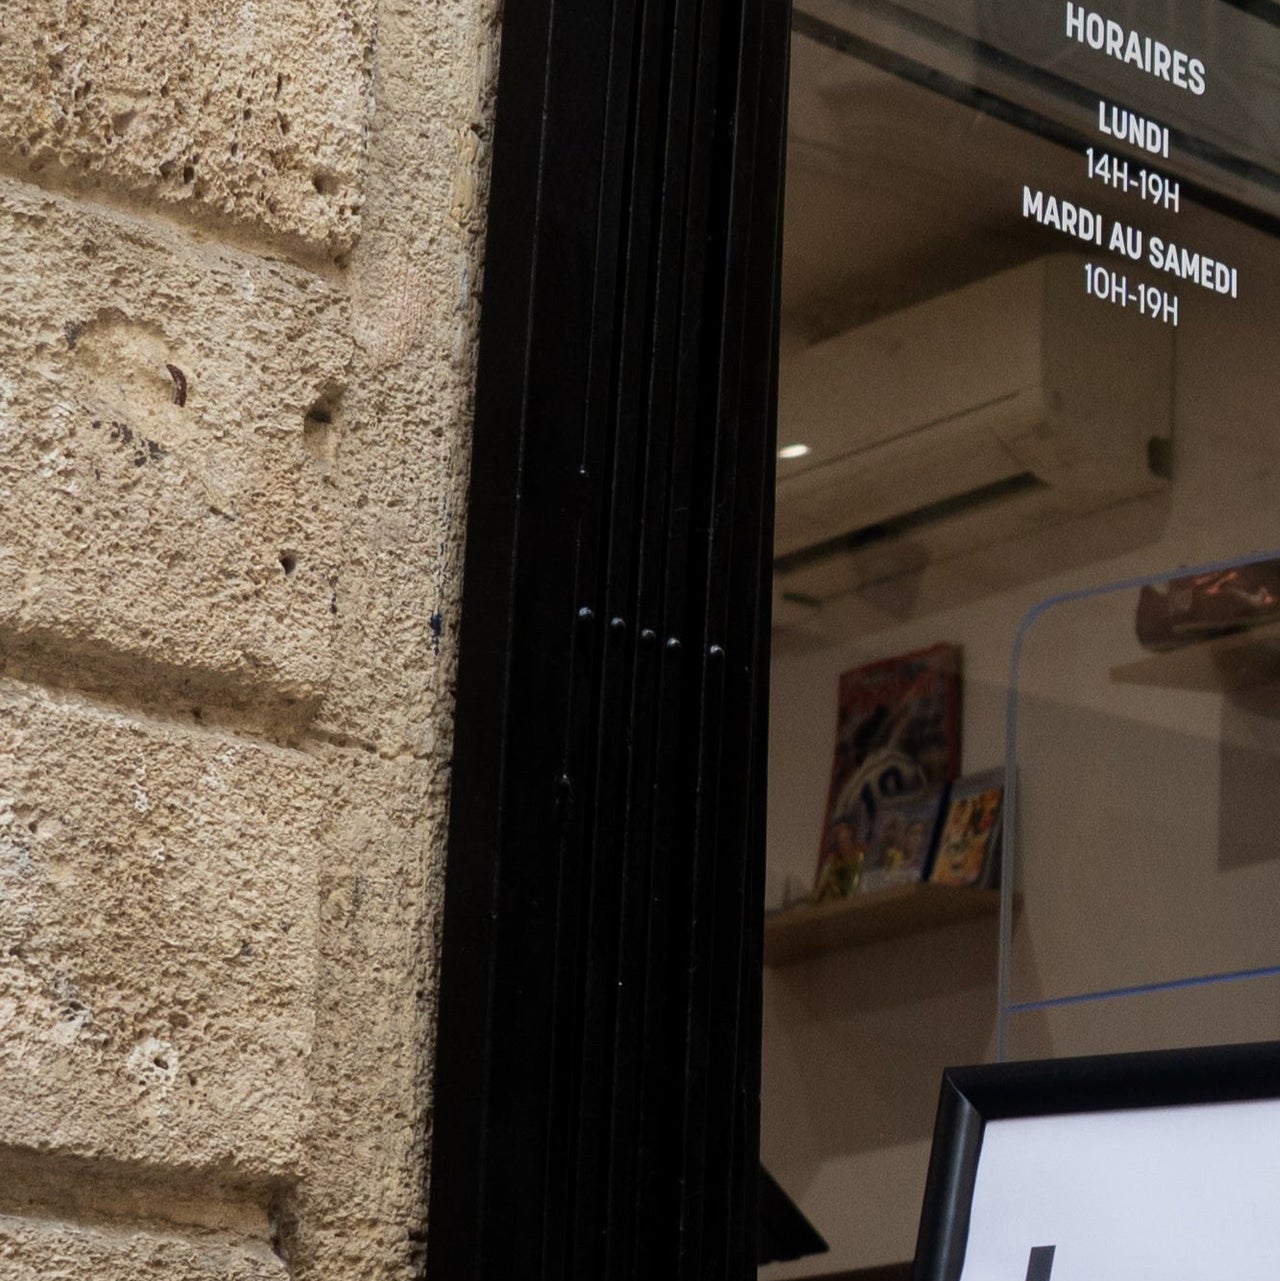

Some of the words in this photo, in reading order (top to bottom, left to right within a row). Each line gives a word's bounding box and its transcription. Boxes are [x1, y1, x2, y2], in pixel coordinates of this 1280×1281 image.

[1066, 1, 1207, 96] HORAIRES
[1099, 101, 1170, 159] LUNDI
[1086, 147, 1180, 214] 14H-19H
[1023, 185, 1103, 246] MARDI
[1109, 221, 1143, 261] AU
[1149, 236, 1239, 299] SAMEDI
[1085, 263, 1179, 327] 10H-19H
